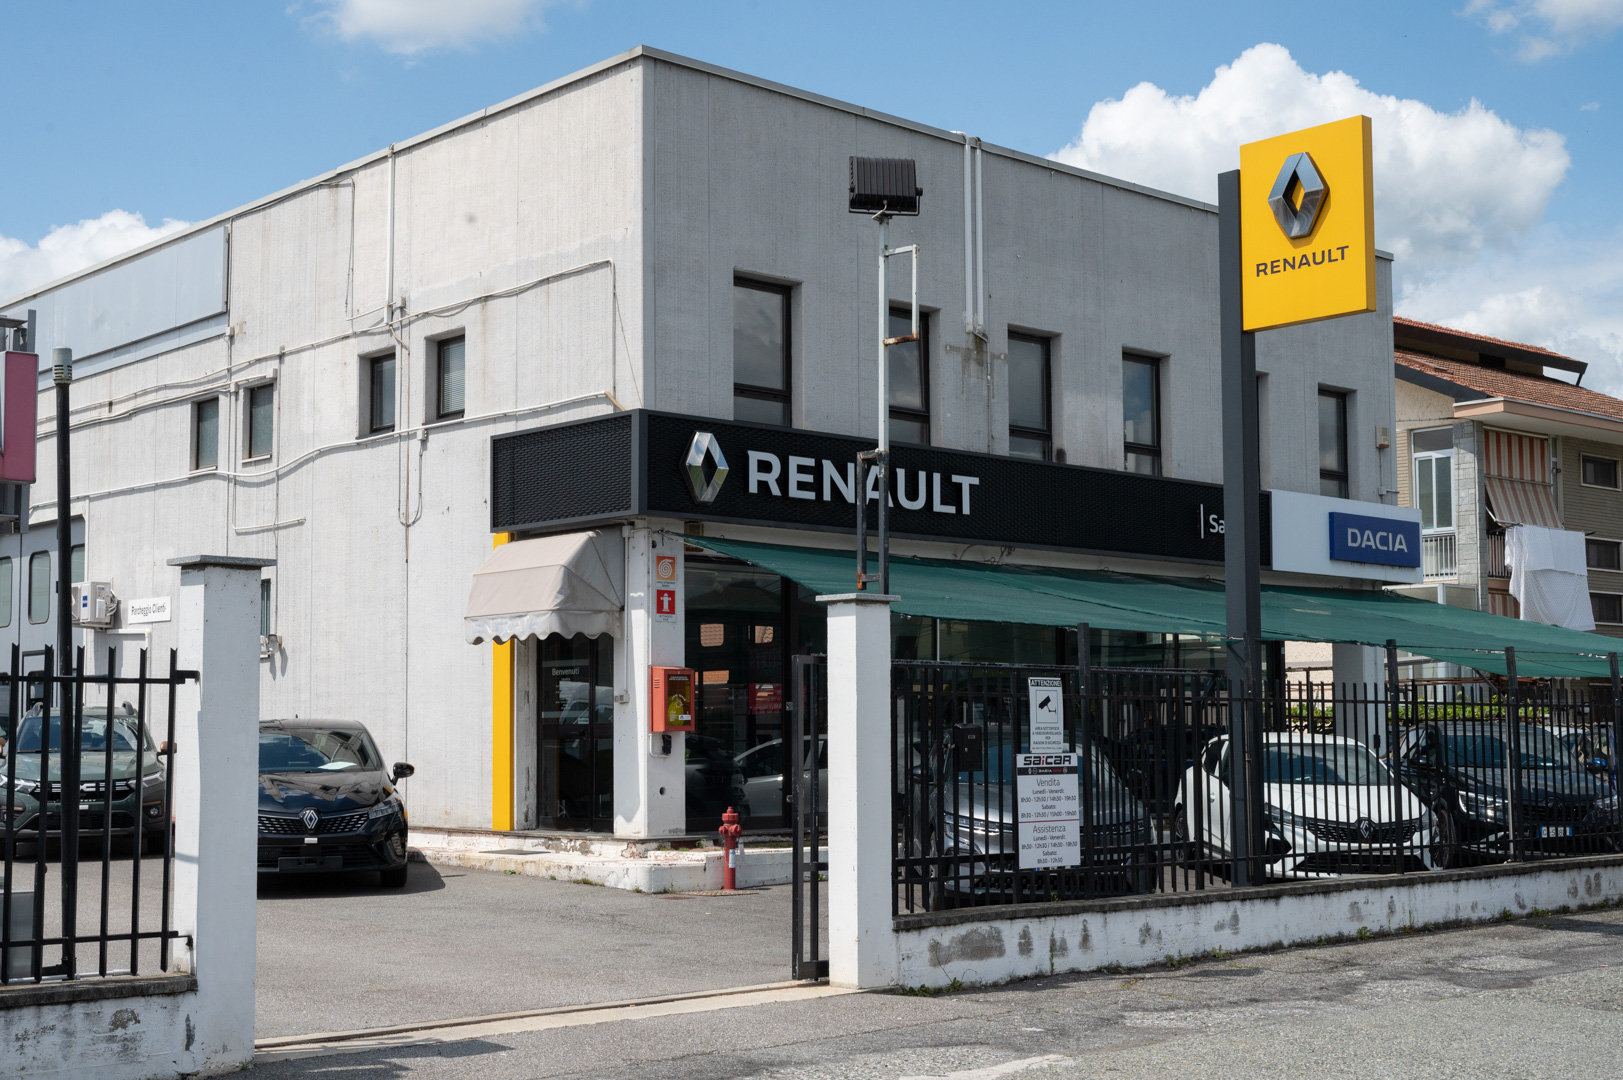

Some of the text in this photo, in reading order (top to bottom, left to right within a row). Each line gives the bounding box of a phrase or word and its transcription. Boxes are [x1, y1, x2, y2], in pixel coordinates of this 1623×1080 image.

[1256, 245, 1349, 277] RENAULT
[748, 450, 980, 515] RENAULT
[1209, 514, 1225, 534] Sa
[1347, 528, 1408, 553] DACIA
[551, 667, 580, 676] Benvenuti
[1036, 778, 1061, 787] Vendita
[1033, 825, 1066, 834] Assistenza
